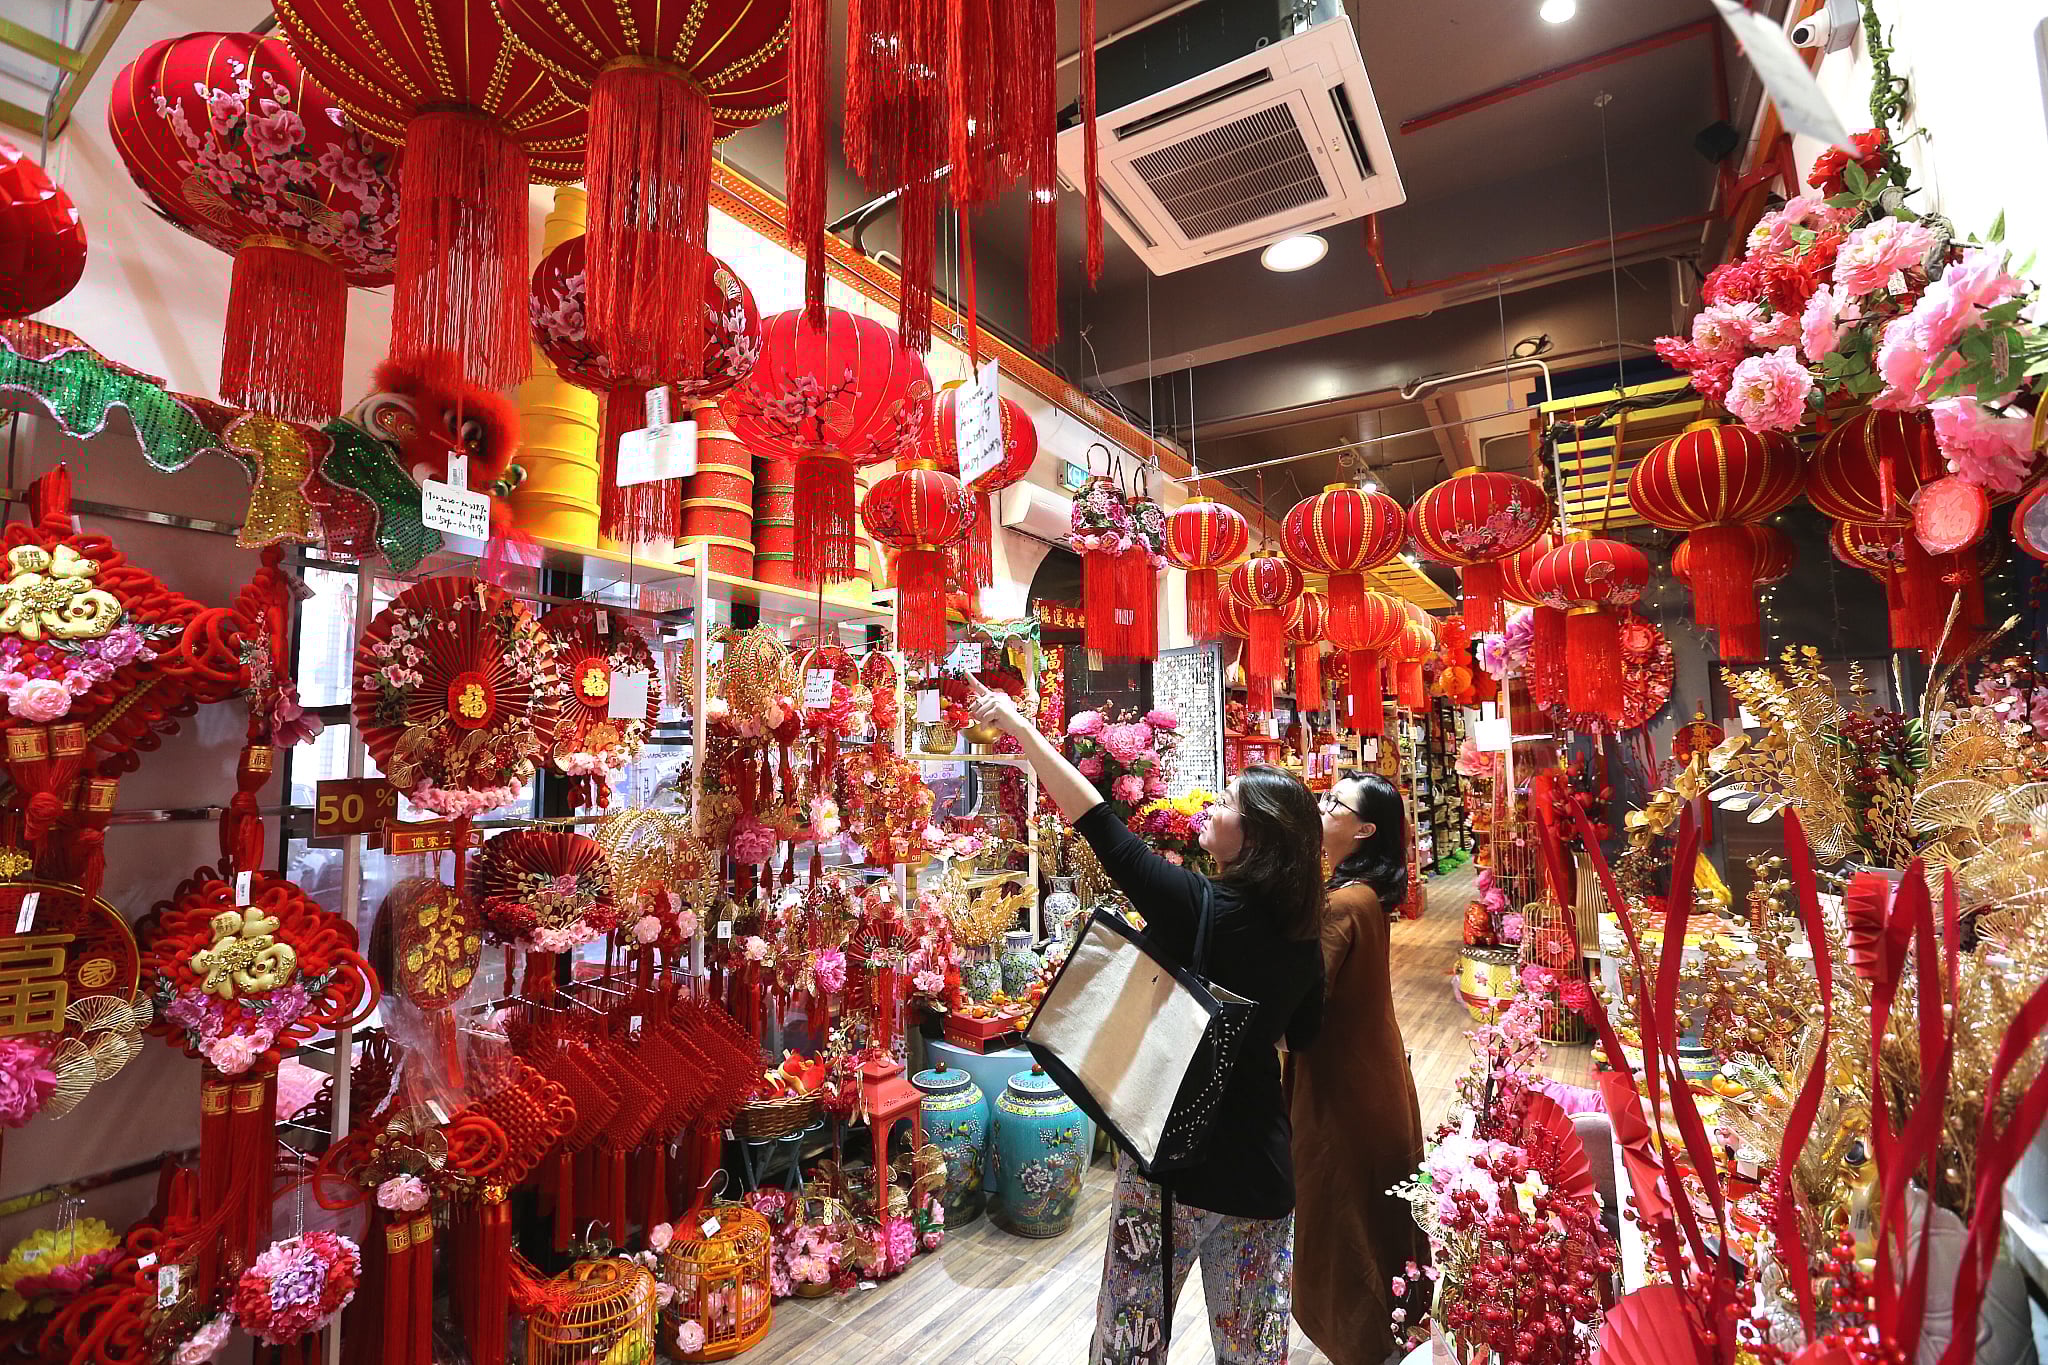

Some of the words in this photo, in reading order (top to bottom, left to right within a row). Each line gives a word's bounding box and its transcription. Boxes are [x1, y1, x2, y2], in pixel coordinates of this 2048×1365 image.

[1931, 488, 1972, 540] 福
[458, 683, 488, 719] 福
[318, 794, 363, 825] 50
[376, 788, 396, 808] %
[679, 850, 693, 862] 50
[191, 906, 297, 1000] 福
